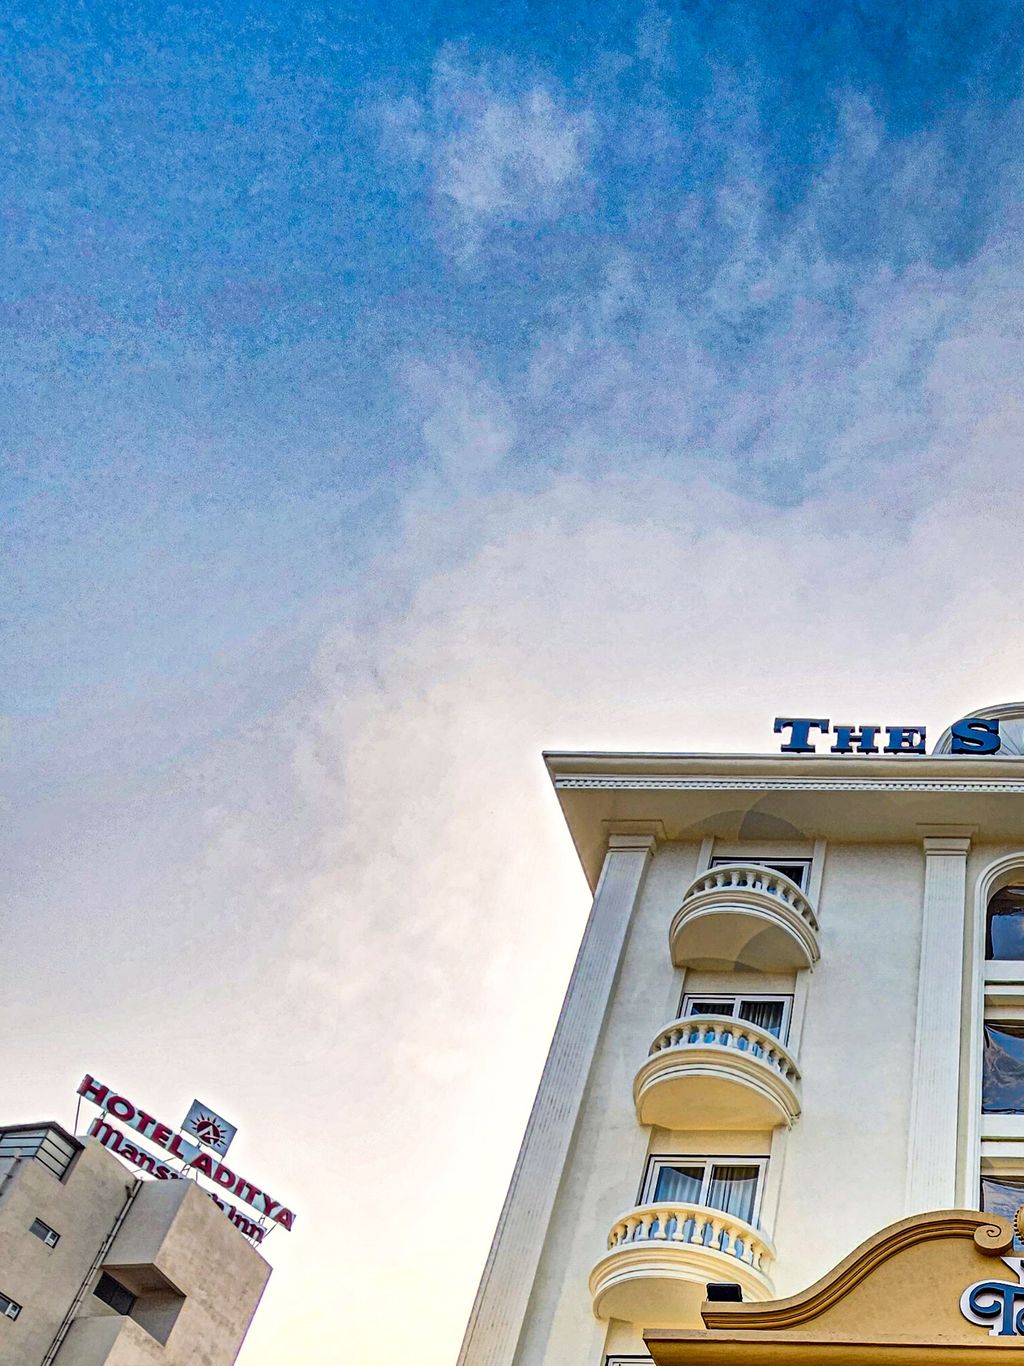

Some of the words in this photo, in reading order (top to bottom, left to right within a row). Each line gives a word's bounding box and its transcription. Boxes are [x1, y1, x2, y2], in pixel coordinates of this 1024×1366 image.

[951, 718, 1001, 755] S
[76, 1073, 185, 1161] HOTEL
[190, 1152, 297, 1232] ADITYA
